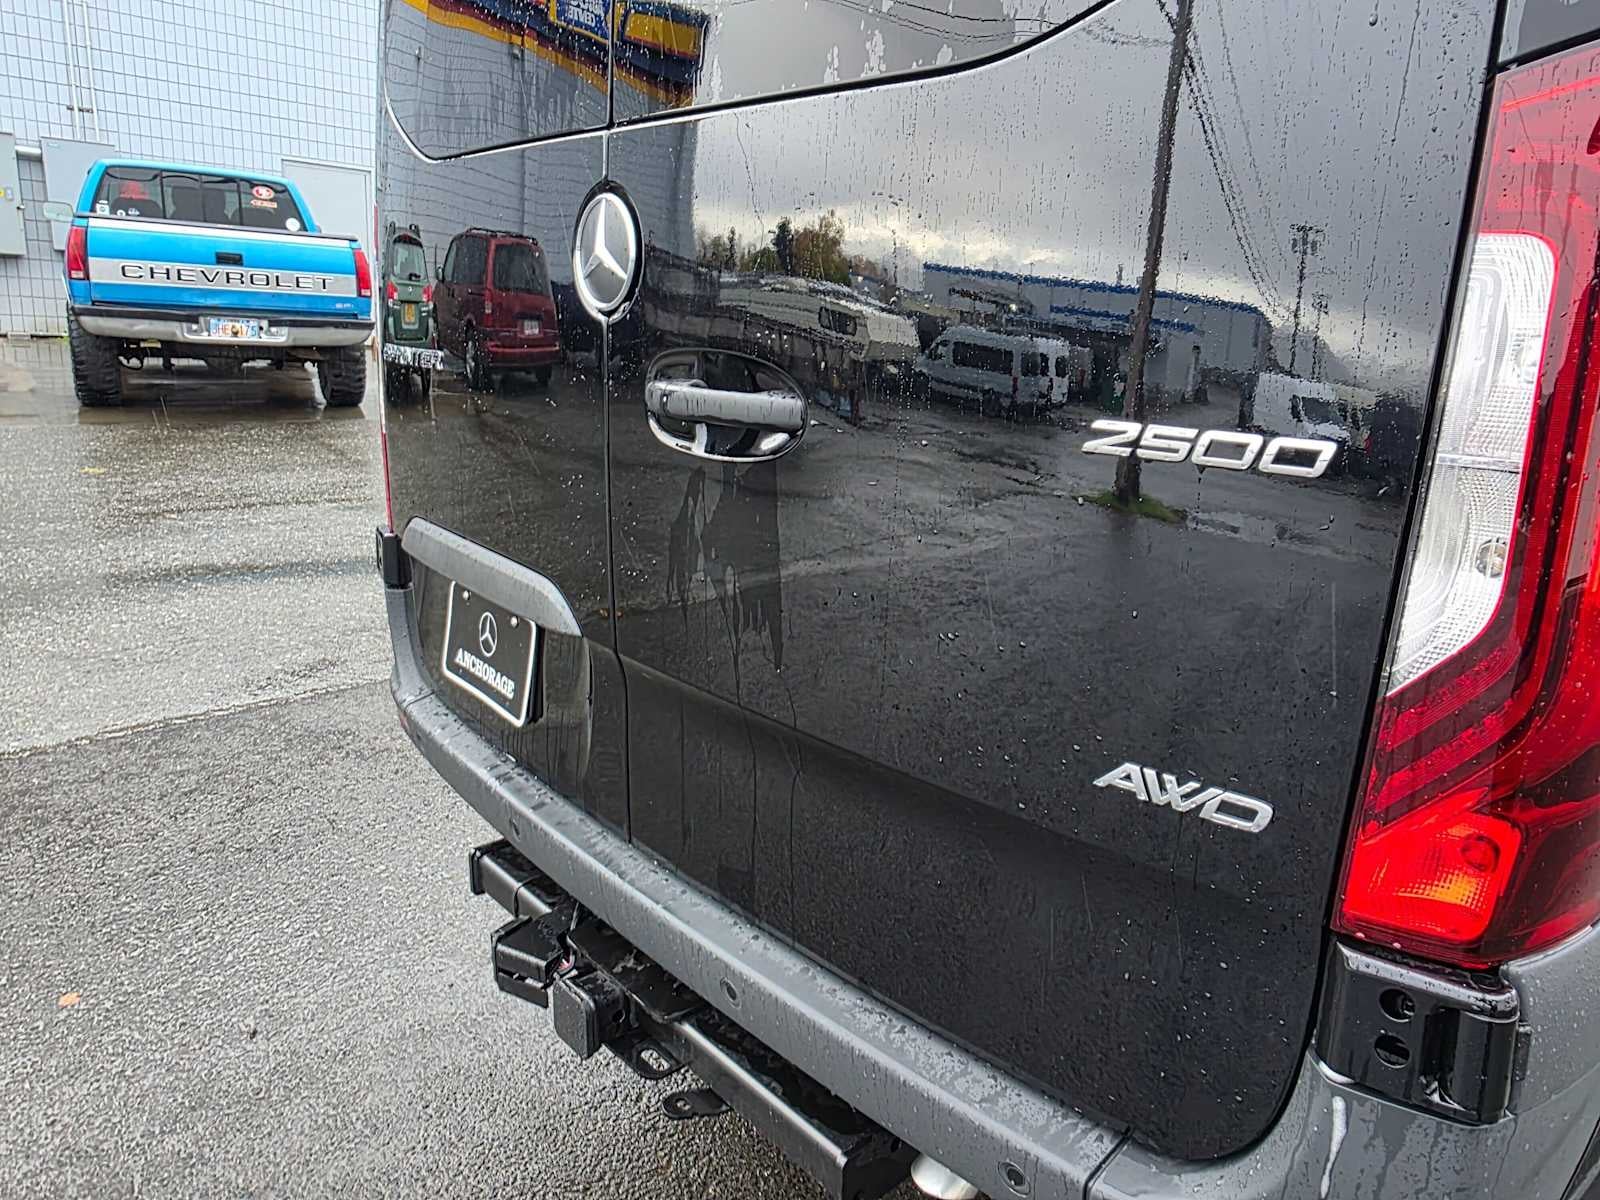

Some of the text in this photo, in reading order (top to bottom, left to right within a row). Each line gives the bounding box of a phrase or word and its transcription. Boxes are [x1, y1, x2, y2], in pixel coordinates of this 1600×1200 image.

[120, 263, 334, 291] CHEVROLET
[1081, 419, 1338, 478] 2500
[455, 647, 515, 699] ANCHORAGE
[1093, 762, 1274, 833] AWD
